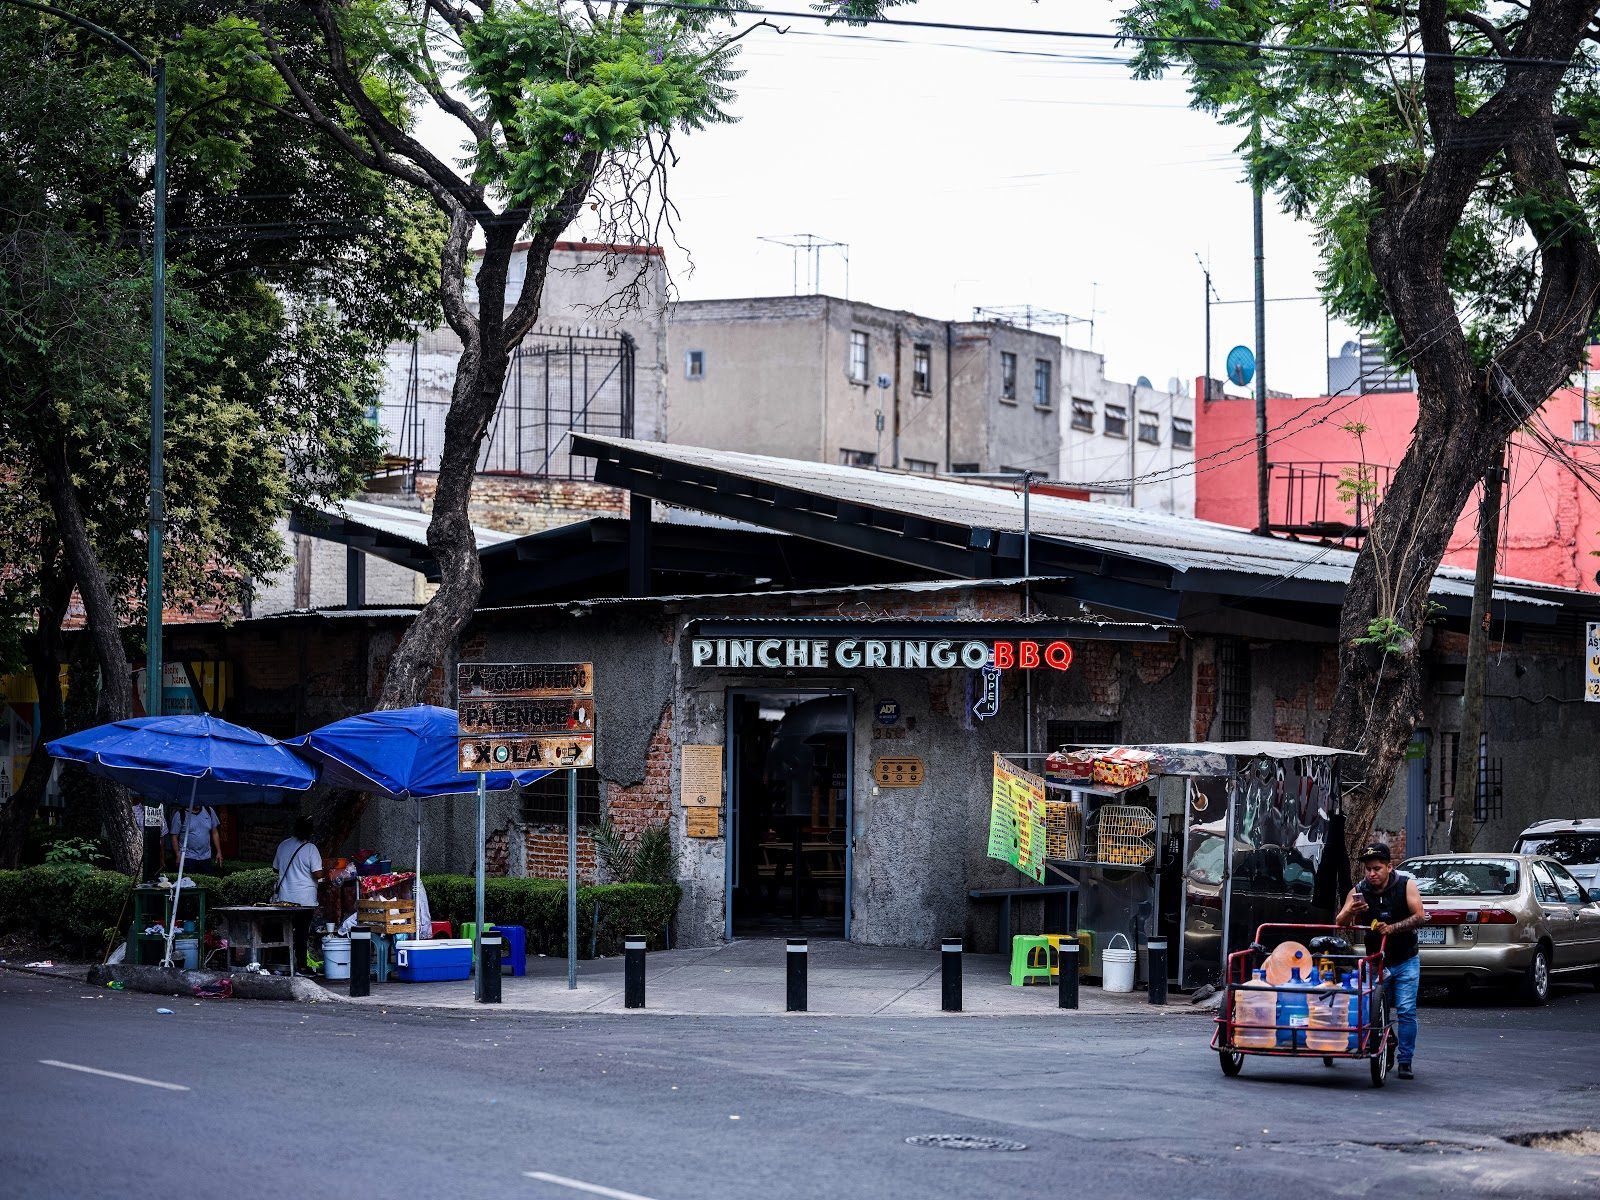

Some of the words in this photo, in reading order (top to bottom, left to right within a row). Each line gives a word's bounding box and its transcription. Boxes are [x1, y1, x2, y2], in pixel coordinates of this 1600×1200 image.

[692, 639, 829, 668] PINCHE
[835, 639, 988, 669] GRINGO
[994, 641, 1073, 672] BBQ
[467, 707, 568, 726] PALENQUE
[880, 704, 897, 714] ADT
[475, 744, 542, 764] XOLA
